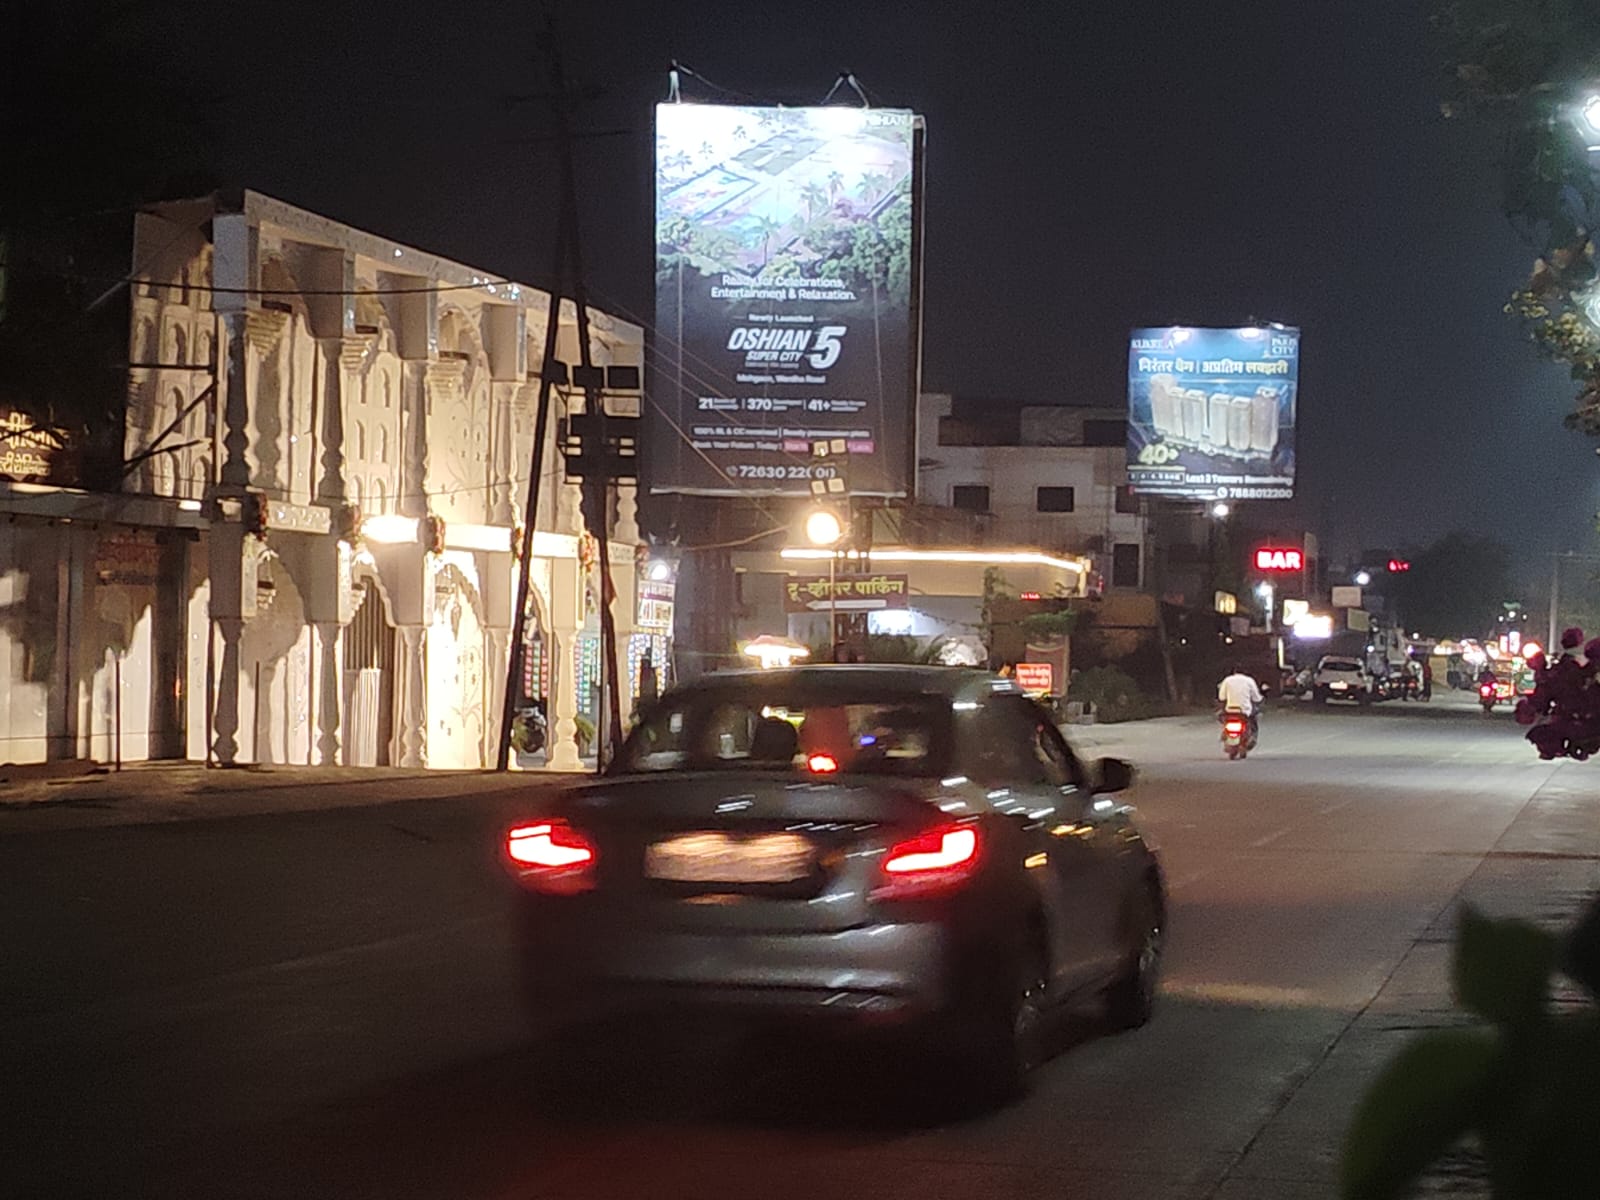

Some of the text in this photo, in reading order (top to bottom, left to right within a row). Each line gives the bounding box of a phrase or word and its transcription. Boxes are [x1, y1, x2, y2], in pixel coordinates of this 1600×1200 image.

[775, 276, 846, 288] Celebrations,
[711, 286, 857, 300] Entertainment & Relaxation.
[727, 326, 848, 370] OSHIAN 5
[745, 351, 804, 363] SUPER CITY
[698, 397, 713, 410] 21
[747, 397, 772, 411] 370
[1256, 550, 1301, 570] BAR
